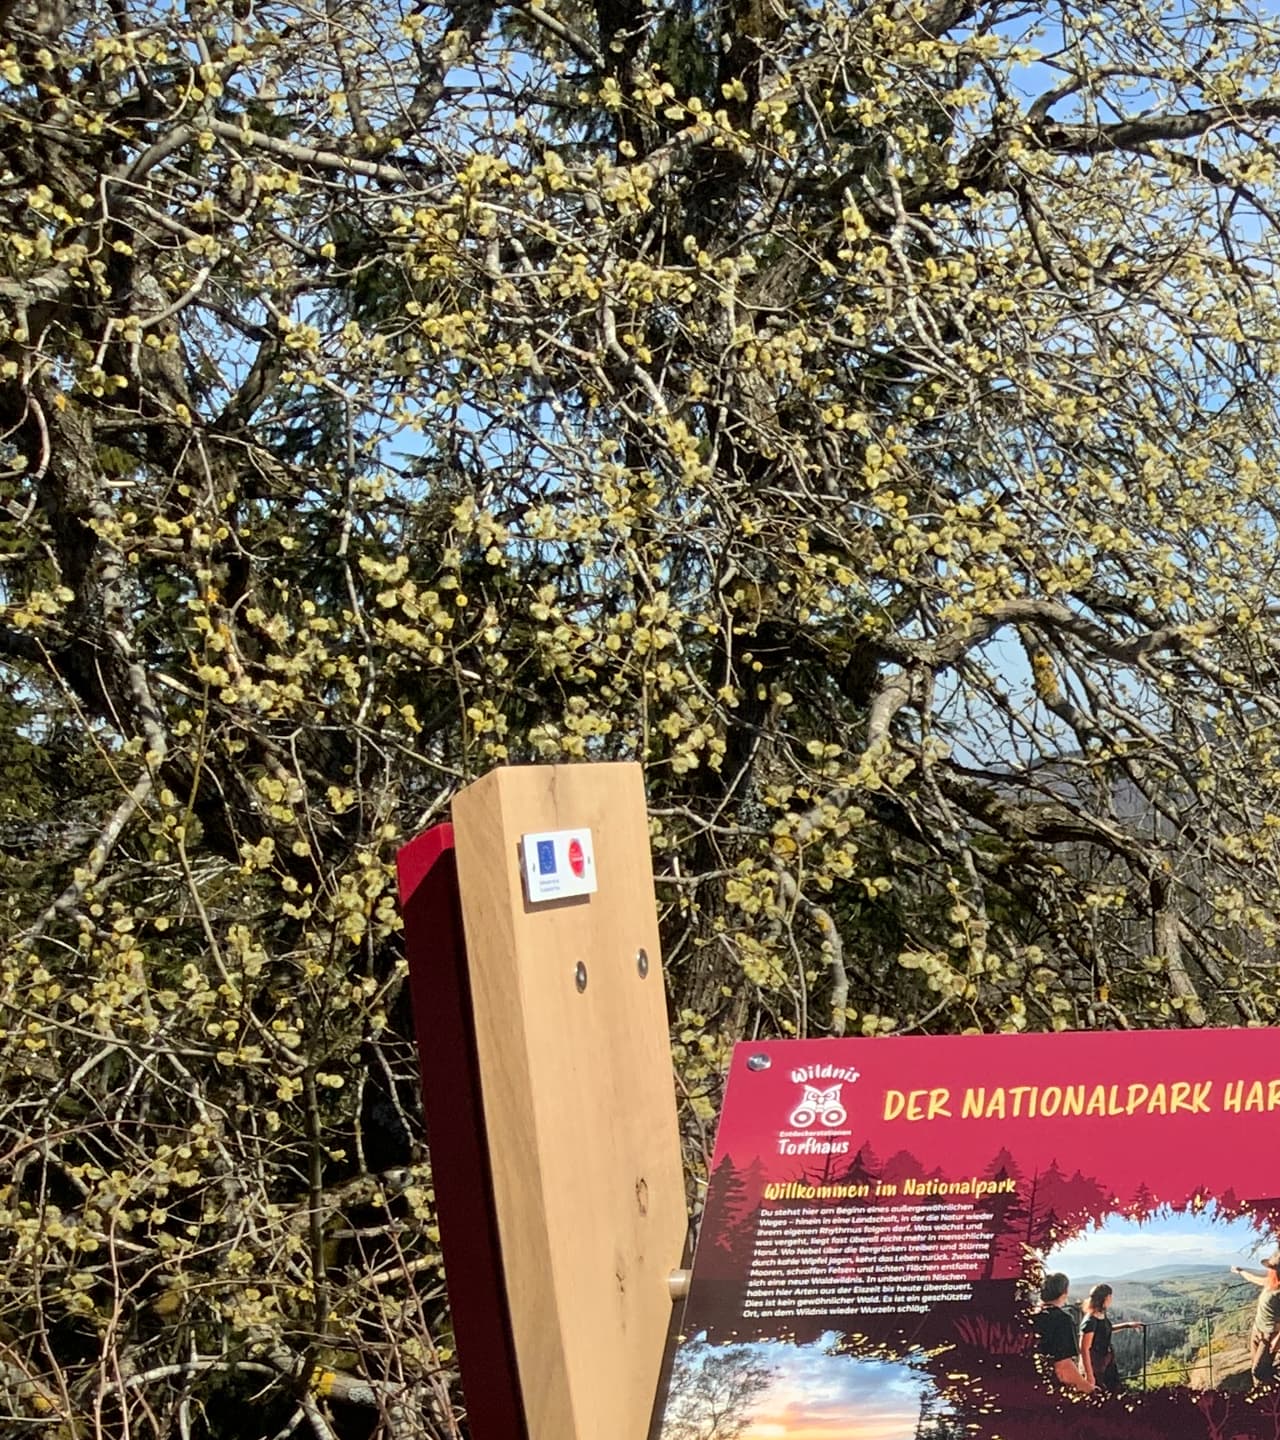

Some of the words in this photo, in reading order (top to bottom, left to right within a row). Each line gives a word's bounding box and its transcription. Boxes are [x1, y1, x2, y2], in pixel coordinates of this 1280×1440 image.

[791, 1064, 860, 1083] Wildnis
[881, 1087, 953, 1124] DER
[961, 1079, 1213, 1120] NATIONALPARK
[778, 1137, 849, 1155] Torfhaus
[762, 1177, 871, 1200] Willkommen
[875, 1177, 898, 1197] im
[901, 1176, 1019, 1196] Nationalpark
[748, 1278, 766, 1287] sich
[766, 1277, 786, 1287] eine
[810, 1275, 865, 1285] Waldwildnis.
[865, 1274, 876, 1284] In
[877, 1273, 931, 1283] unberührten
[931, 1272, 967, 1282] Nischen
[747, 1287, 774, 1297] haben
[775, 1287, 793, 1296] hier
[793, 1286, 818, 1296] Arten
[836, 1285, 852, 1295] der
[852, 1284, 880, 1294] Eiszeit
[881, 1284, 895, 1293] bis
[895, 1283, 921, 1293] heute
[922, 1282, 973, 1292] überdauert.
[742, 1308, 759, 1320] Ort,
[773, 1307, 794, 1317] dem
[795, 1306, 828, 1316] Wildnis
[828, 1305, 859, 1315] wieder
[859, 1304, 895, 1314] Wurzeln
[896, 1303, 931, 1315] schlägt.
